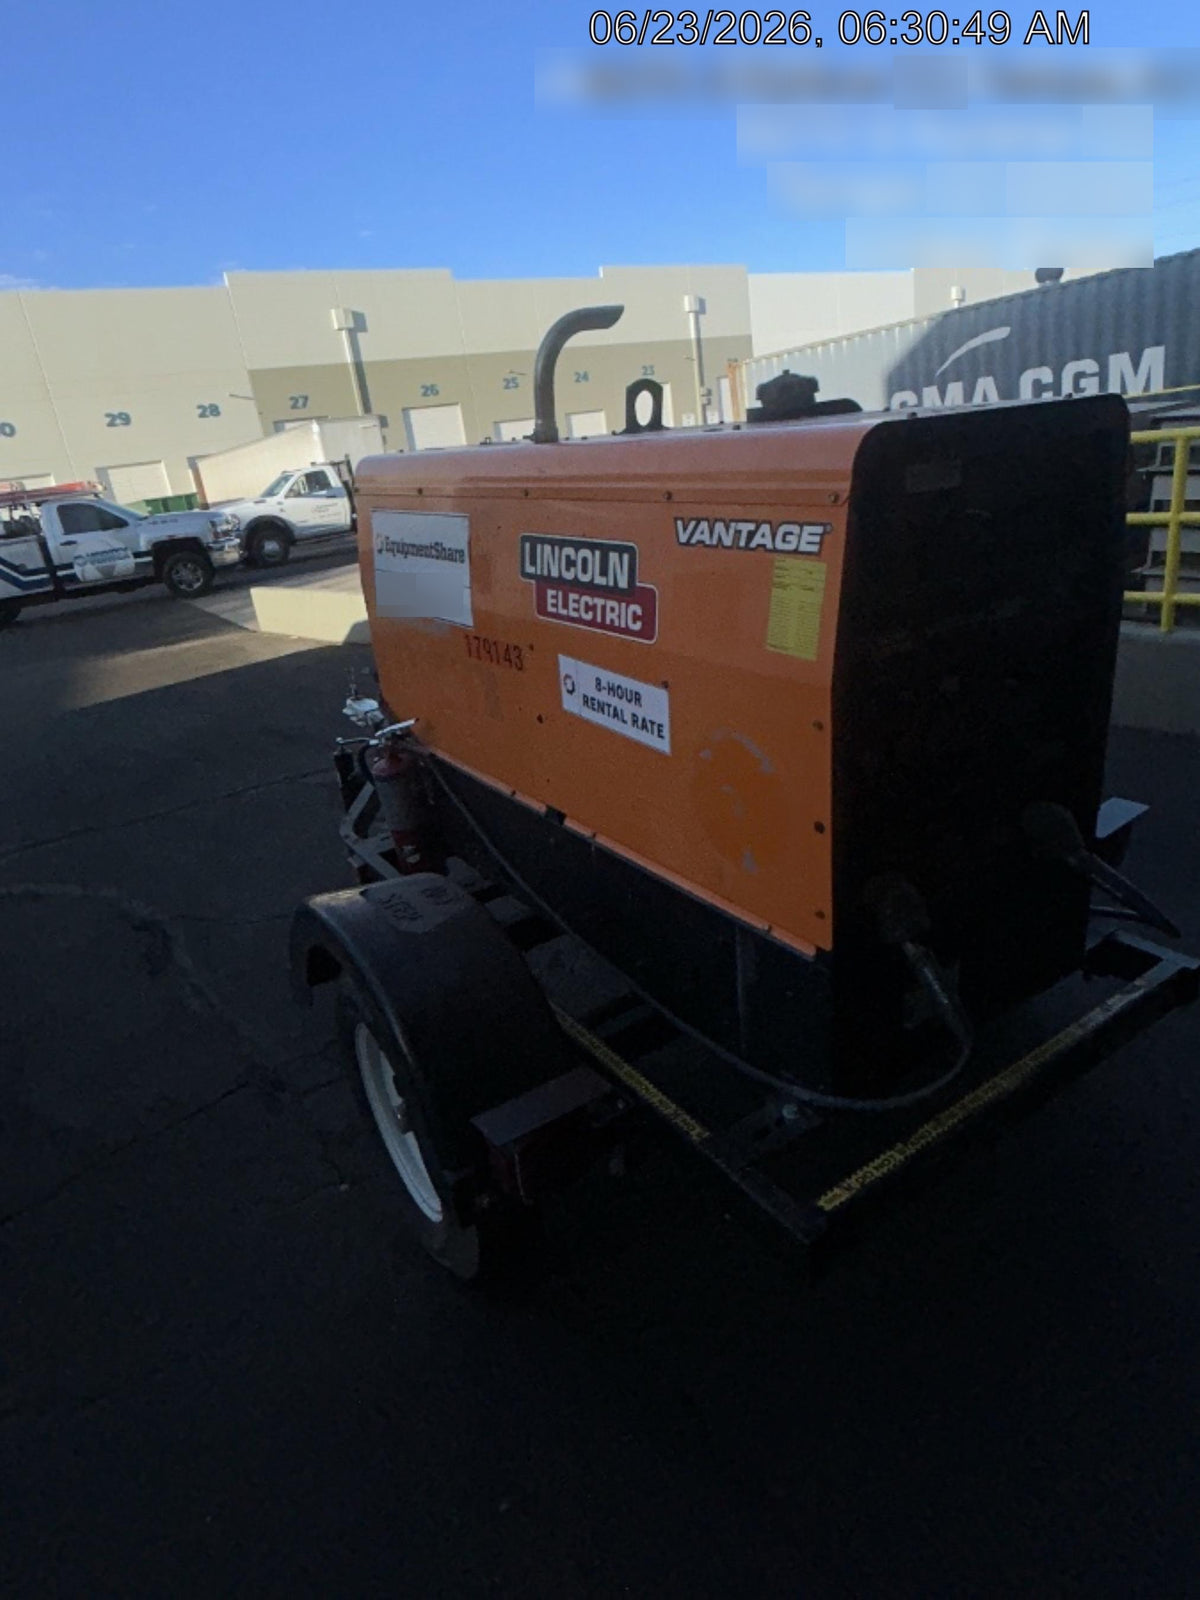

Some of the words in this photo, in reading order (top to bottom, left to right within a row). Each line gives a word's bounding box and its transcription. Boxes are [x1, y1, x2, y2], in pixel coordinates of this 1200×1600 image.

[574, 371, 589, 383] 24
[1019, 345, 1165, 399] CGM
[289, 395, 309, 410] 27
[421, 384, 440, 397] 26
[104, 412, 132, 428] 29
[197, 403, 221, 419] 28
[384, 536, 465, 564] EquipmentShare
[676, 518, 825, 554] VANTAGE
[524, 544, 629, 589] LINCOLN
[546, 589, 643, 632] ELECTRIC
[594, 676, 643, 708] 8-HOUR
[582, 694, 628, 727] RENTAL
[631, 711, 665, 740] RATE
